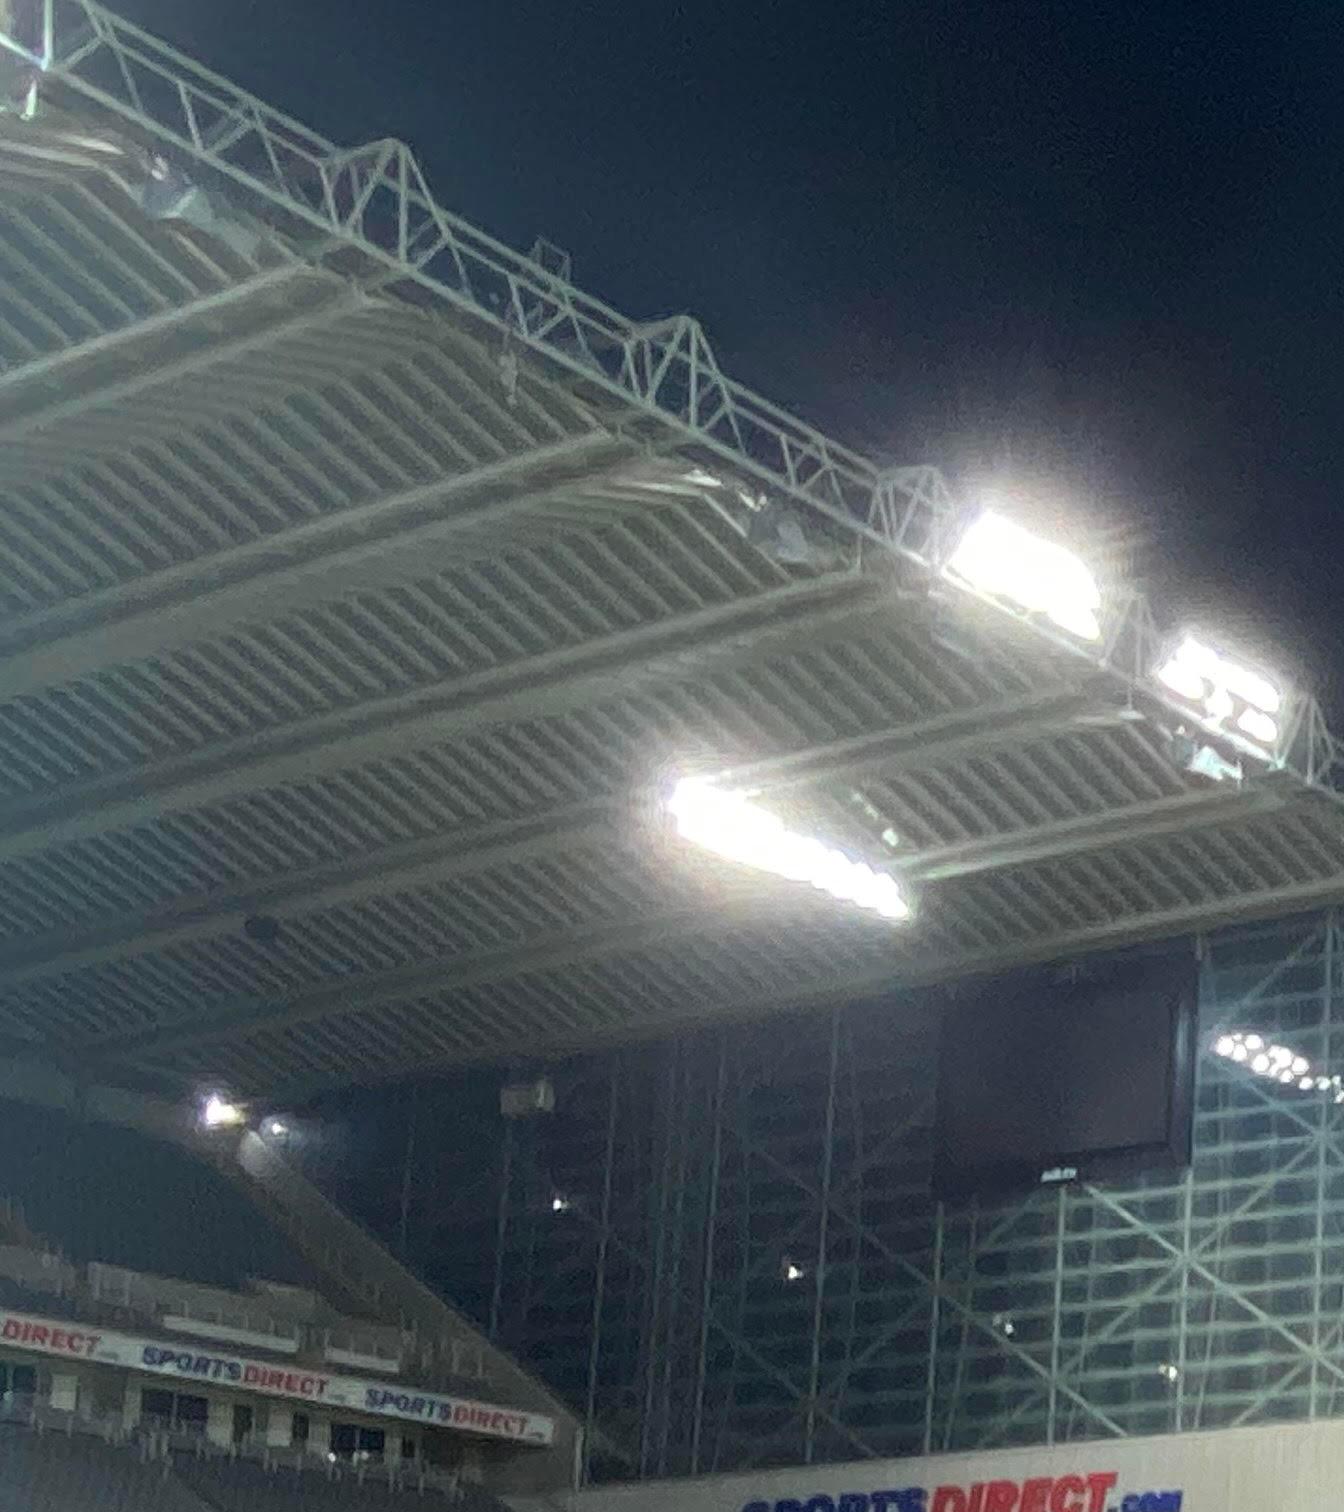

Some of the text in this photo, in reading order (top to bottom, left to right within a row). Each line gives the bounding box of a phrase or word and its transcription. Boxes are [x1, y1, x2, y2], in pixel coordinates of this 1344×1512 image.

[3, 1318, 118, 1361] DIRECT
[142, 1345, 348, 1402] SPORTSDIRECT
[364, 1387, 544, 1440] SPORTSDIRECT
